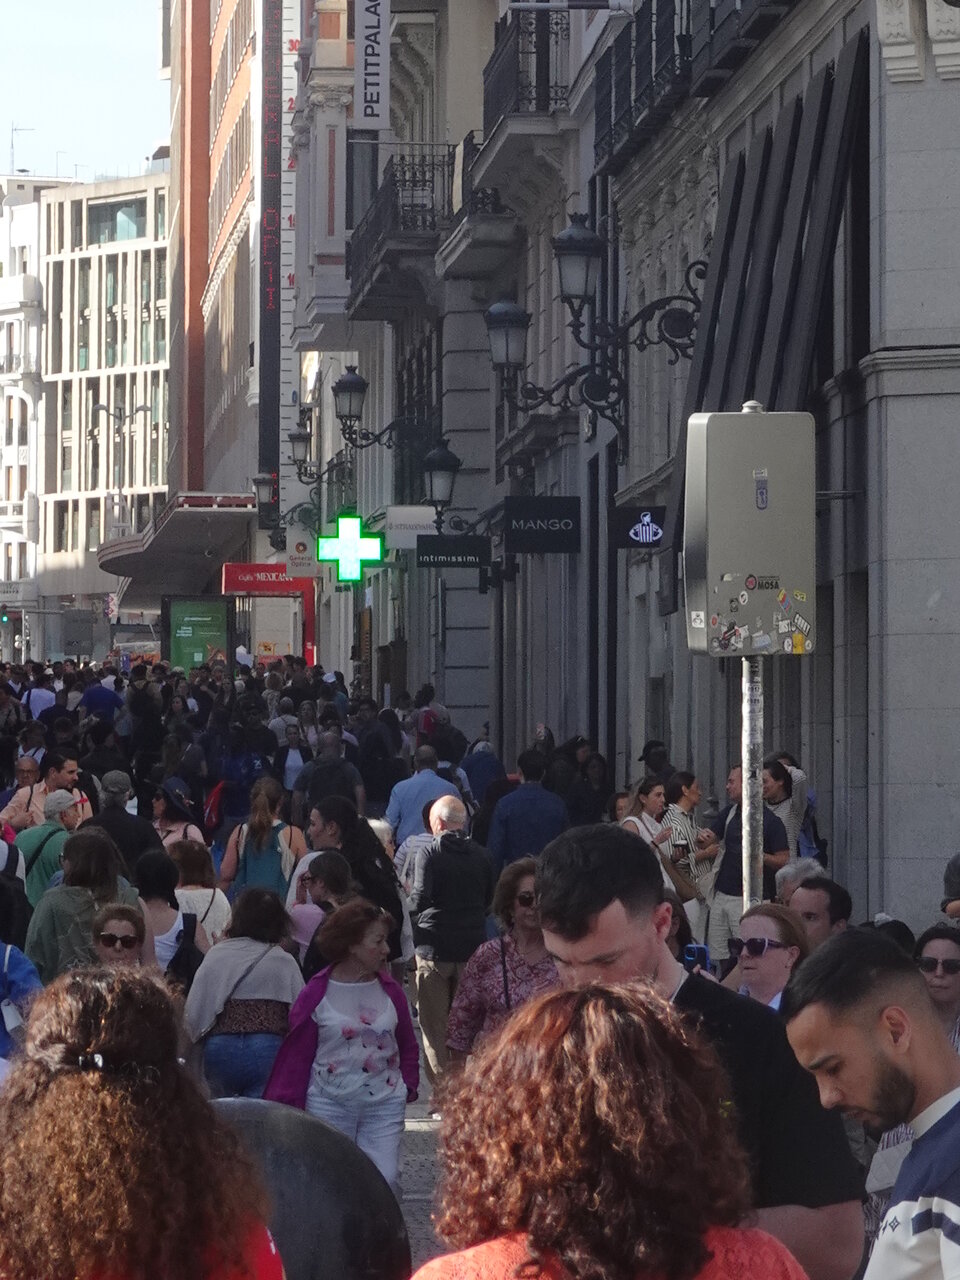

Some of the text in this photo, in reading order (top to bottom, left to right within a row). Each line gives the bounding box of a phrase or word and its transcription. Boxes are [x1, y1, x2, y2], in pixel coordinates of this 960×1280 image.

[287, 97, 296, 111] 2
[287, 157, 296, 169] 2
[511, 519, 573, 531] MANGO
[419, 554, 479, 563] intimissimi
